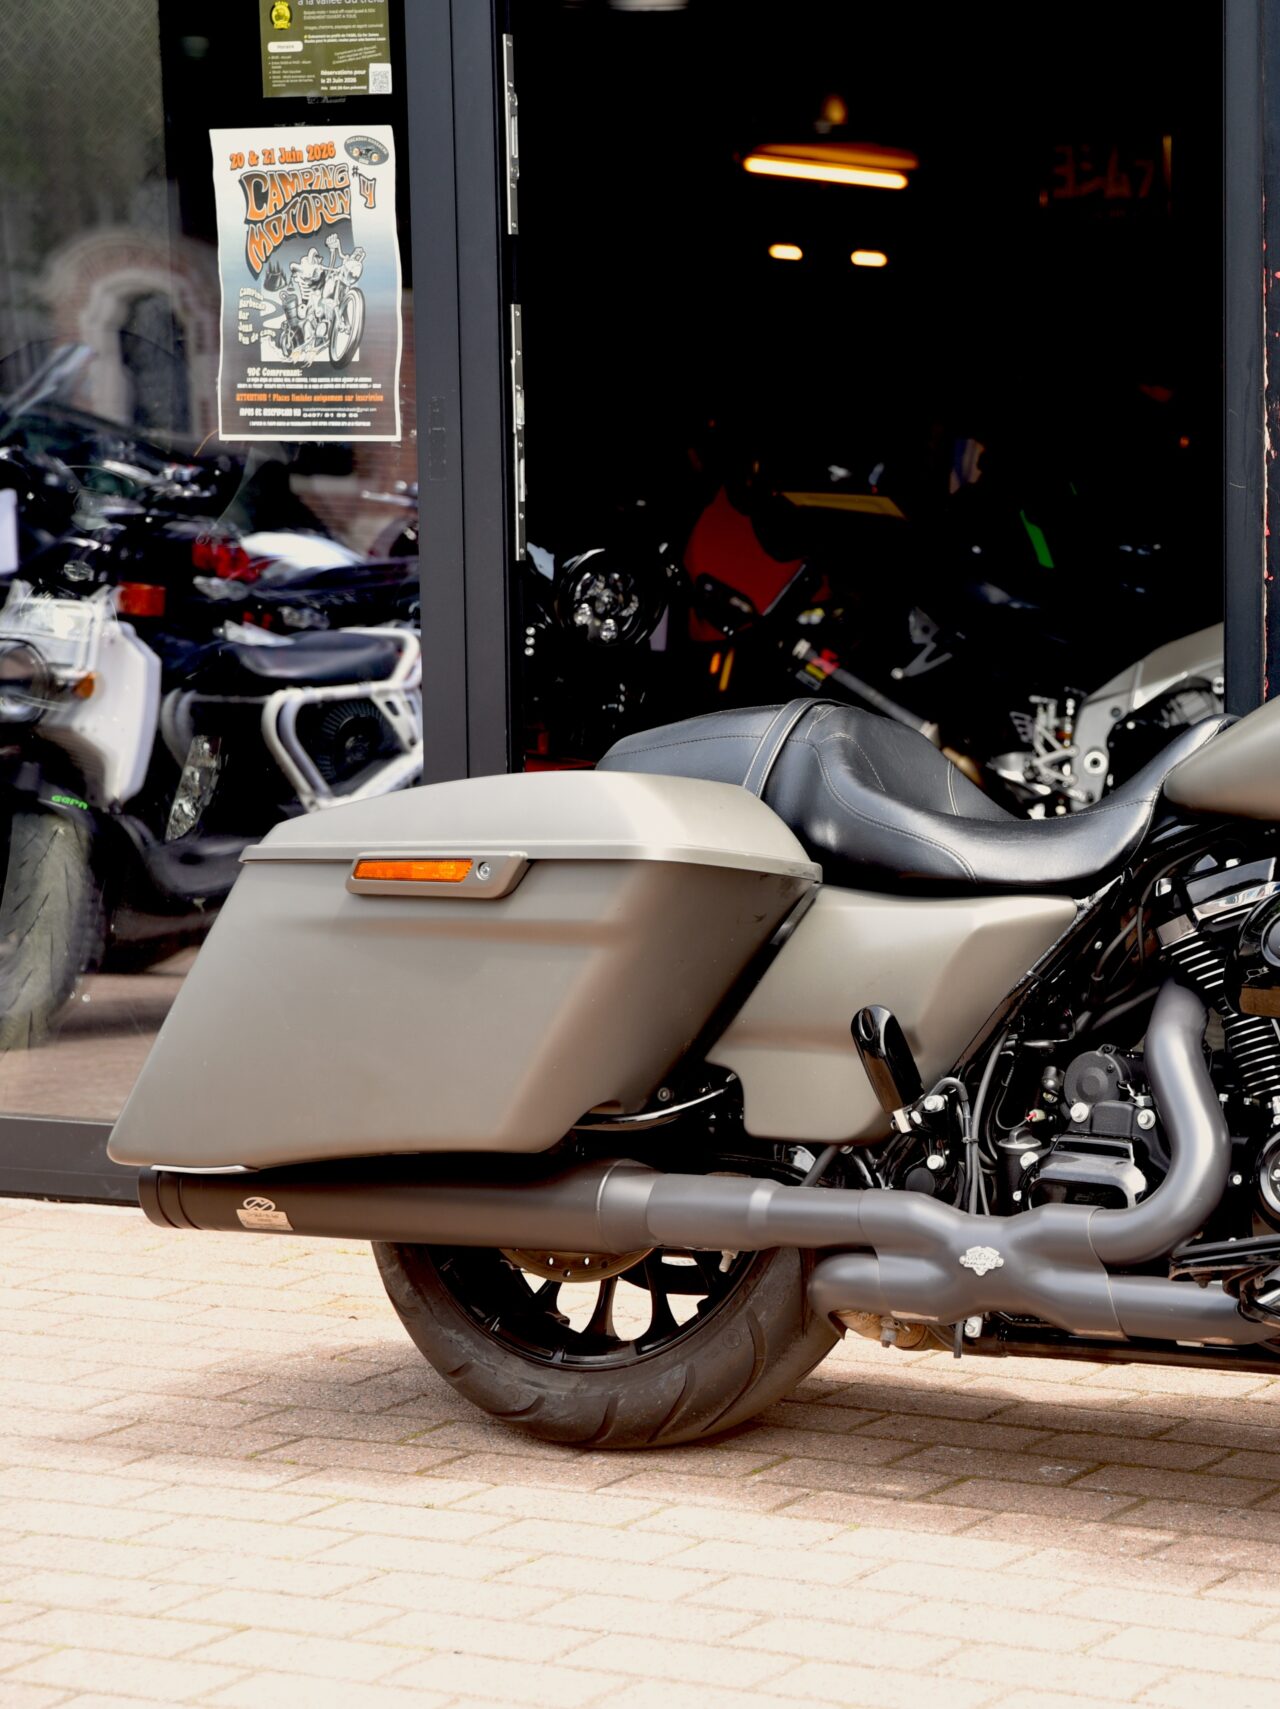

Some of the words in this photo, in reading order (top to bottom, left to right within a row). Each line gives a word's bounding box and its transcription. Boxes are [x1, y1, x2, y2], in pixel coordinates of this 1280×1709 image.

[230, 152, 245, 170] 20
[249, 151, 259, 166] &
[262, 149, 275, 164] 21
[279, 147, 303, 163] Juin
[306, 142, 336, 161] 2026
[247, 188, 350, 274] MOTORUN
